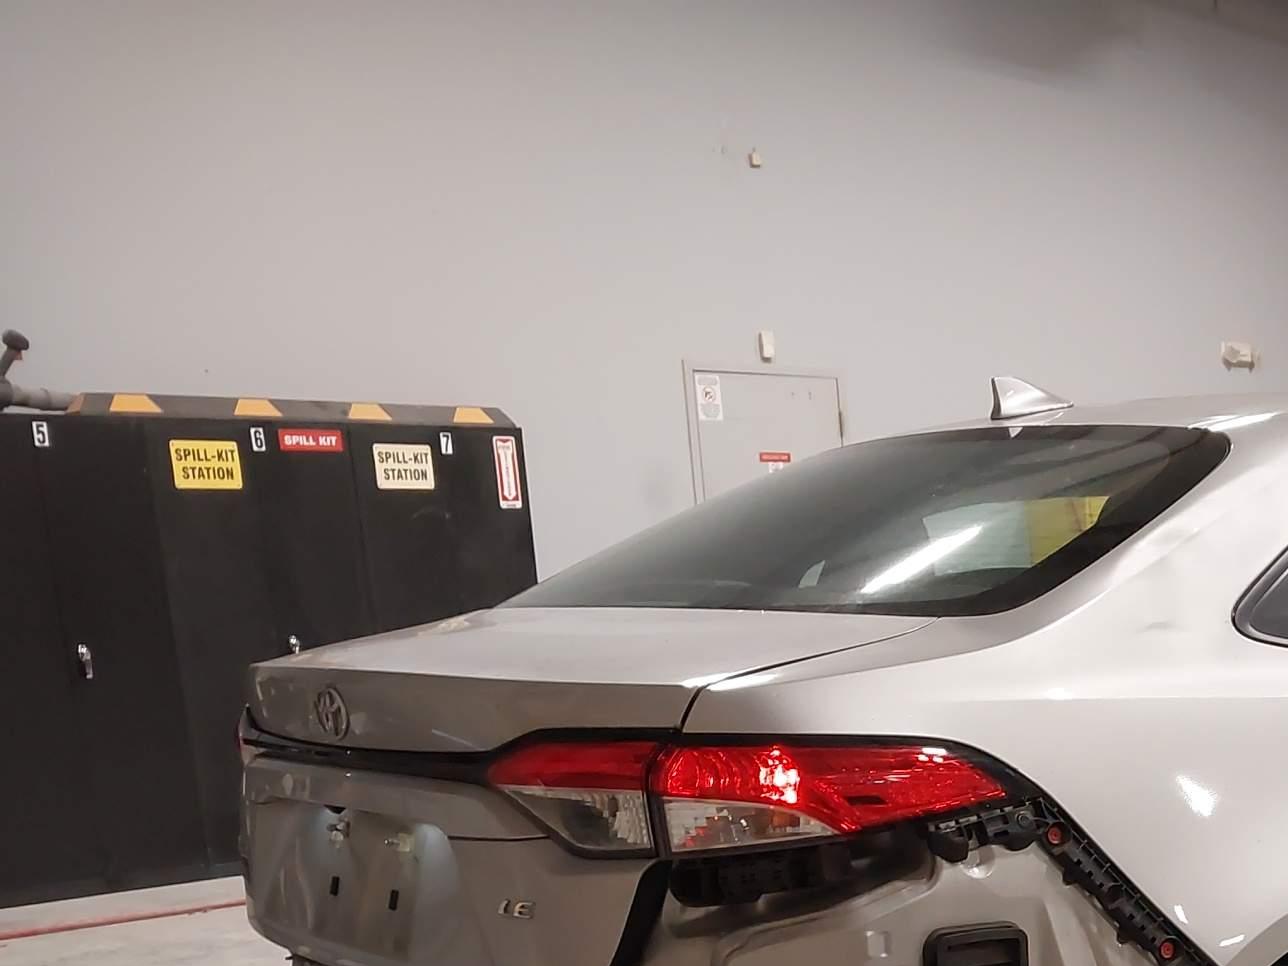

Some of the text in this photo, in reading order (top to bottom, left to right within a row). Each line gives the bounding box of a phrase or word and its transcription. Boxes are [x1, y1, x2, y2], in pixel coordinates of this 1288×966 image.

[35, 423, 47, 445] 5
[253, 429, 264, 449] 6
[283, 434, 338, 447] SPILL KIT
[442, 434, 450, 454] 7
[174, 447, 236, 463] SPILL-KIT
[377, 450, 430, 465] SPILL-KIT
[182, 466, 235, 481] STATION
[383, 468, 428, 482] STATION
